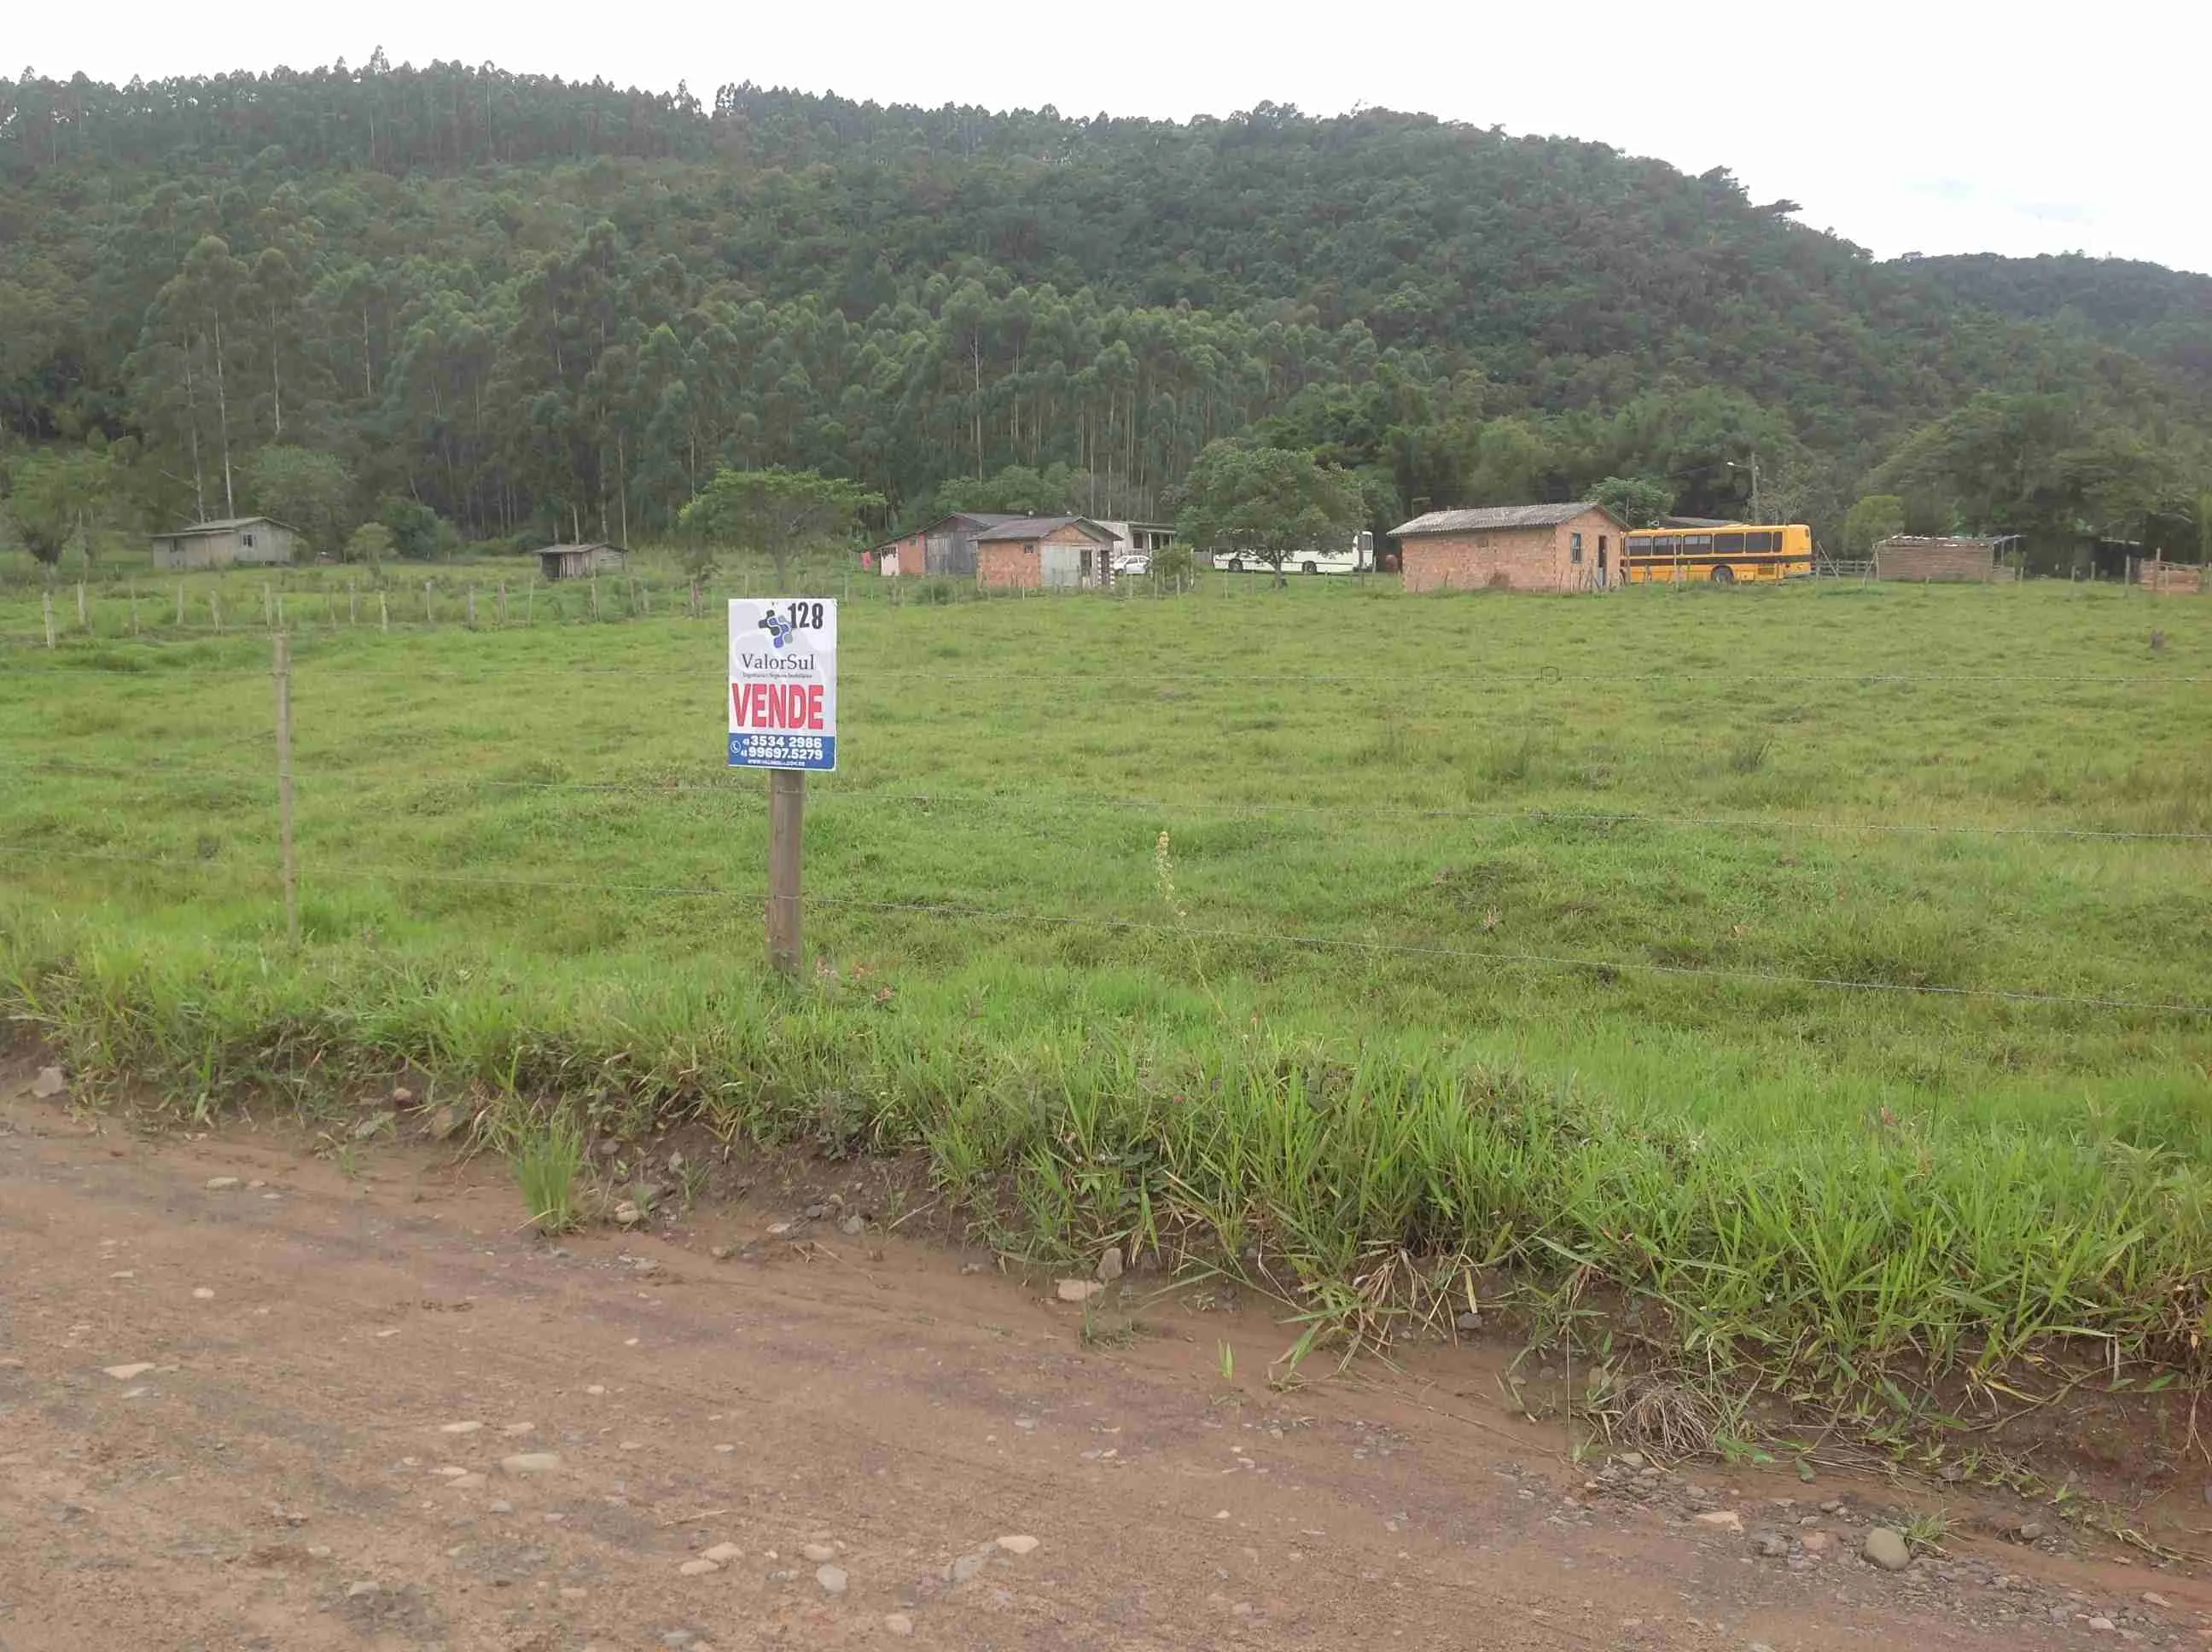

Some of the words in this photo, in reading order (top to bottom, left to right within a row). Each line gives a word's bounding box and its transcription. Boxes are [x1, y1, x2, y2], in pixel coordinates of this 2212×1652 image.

[788, 602, 824, 630] 128
[742, 654, 815, 670] ValorSul
[731, 683, 824, 730] VENDE
[750, 735, 785, 747] 3534
[748, 747, 824, 760] 99697.5279
